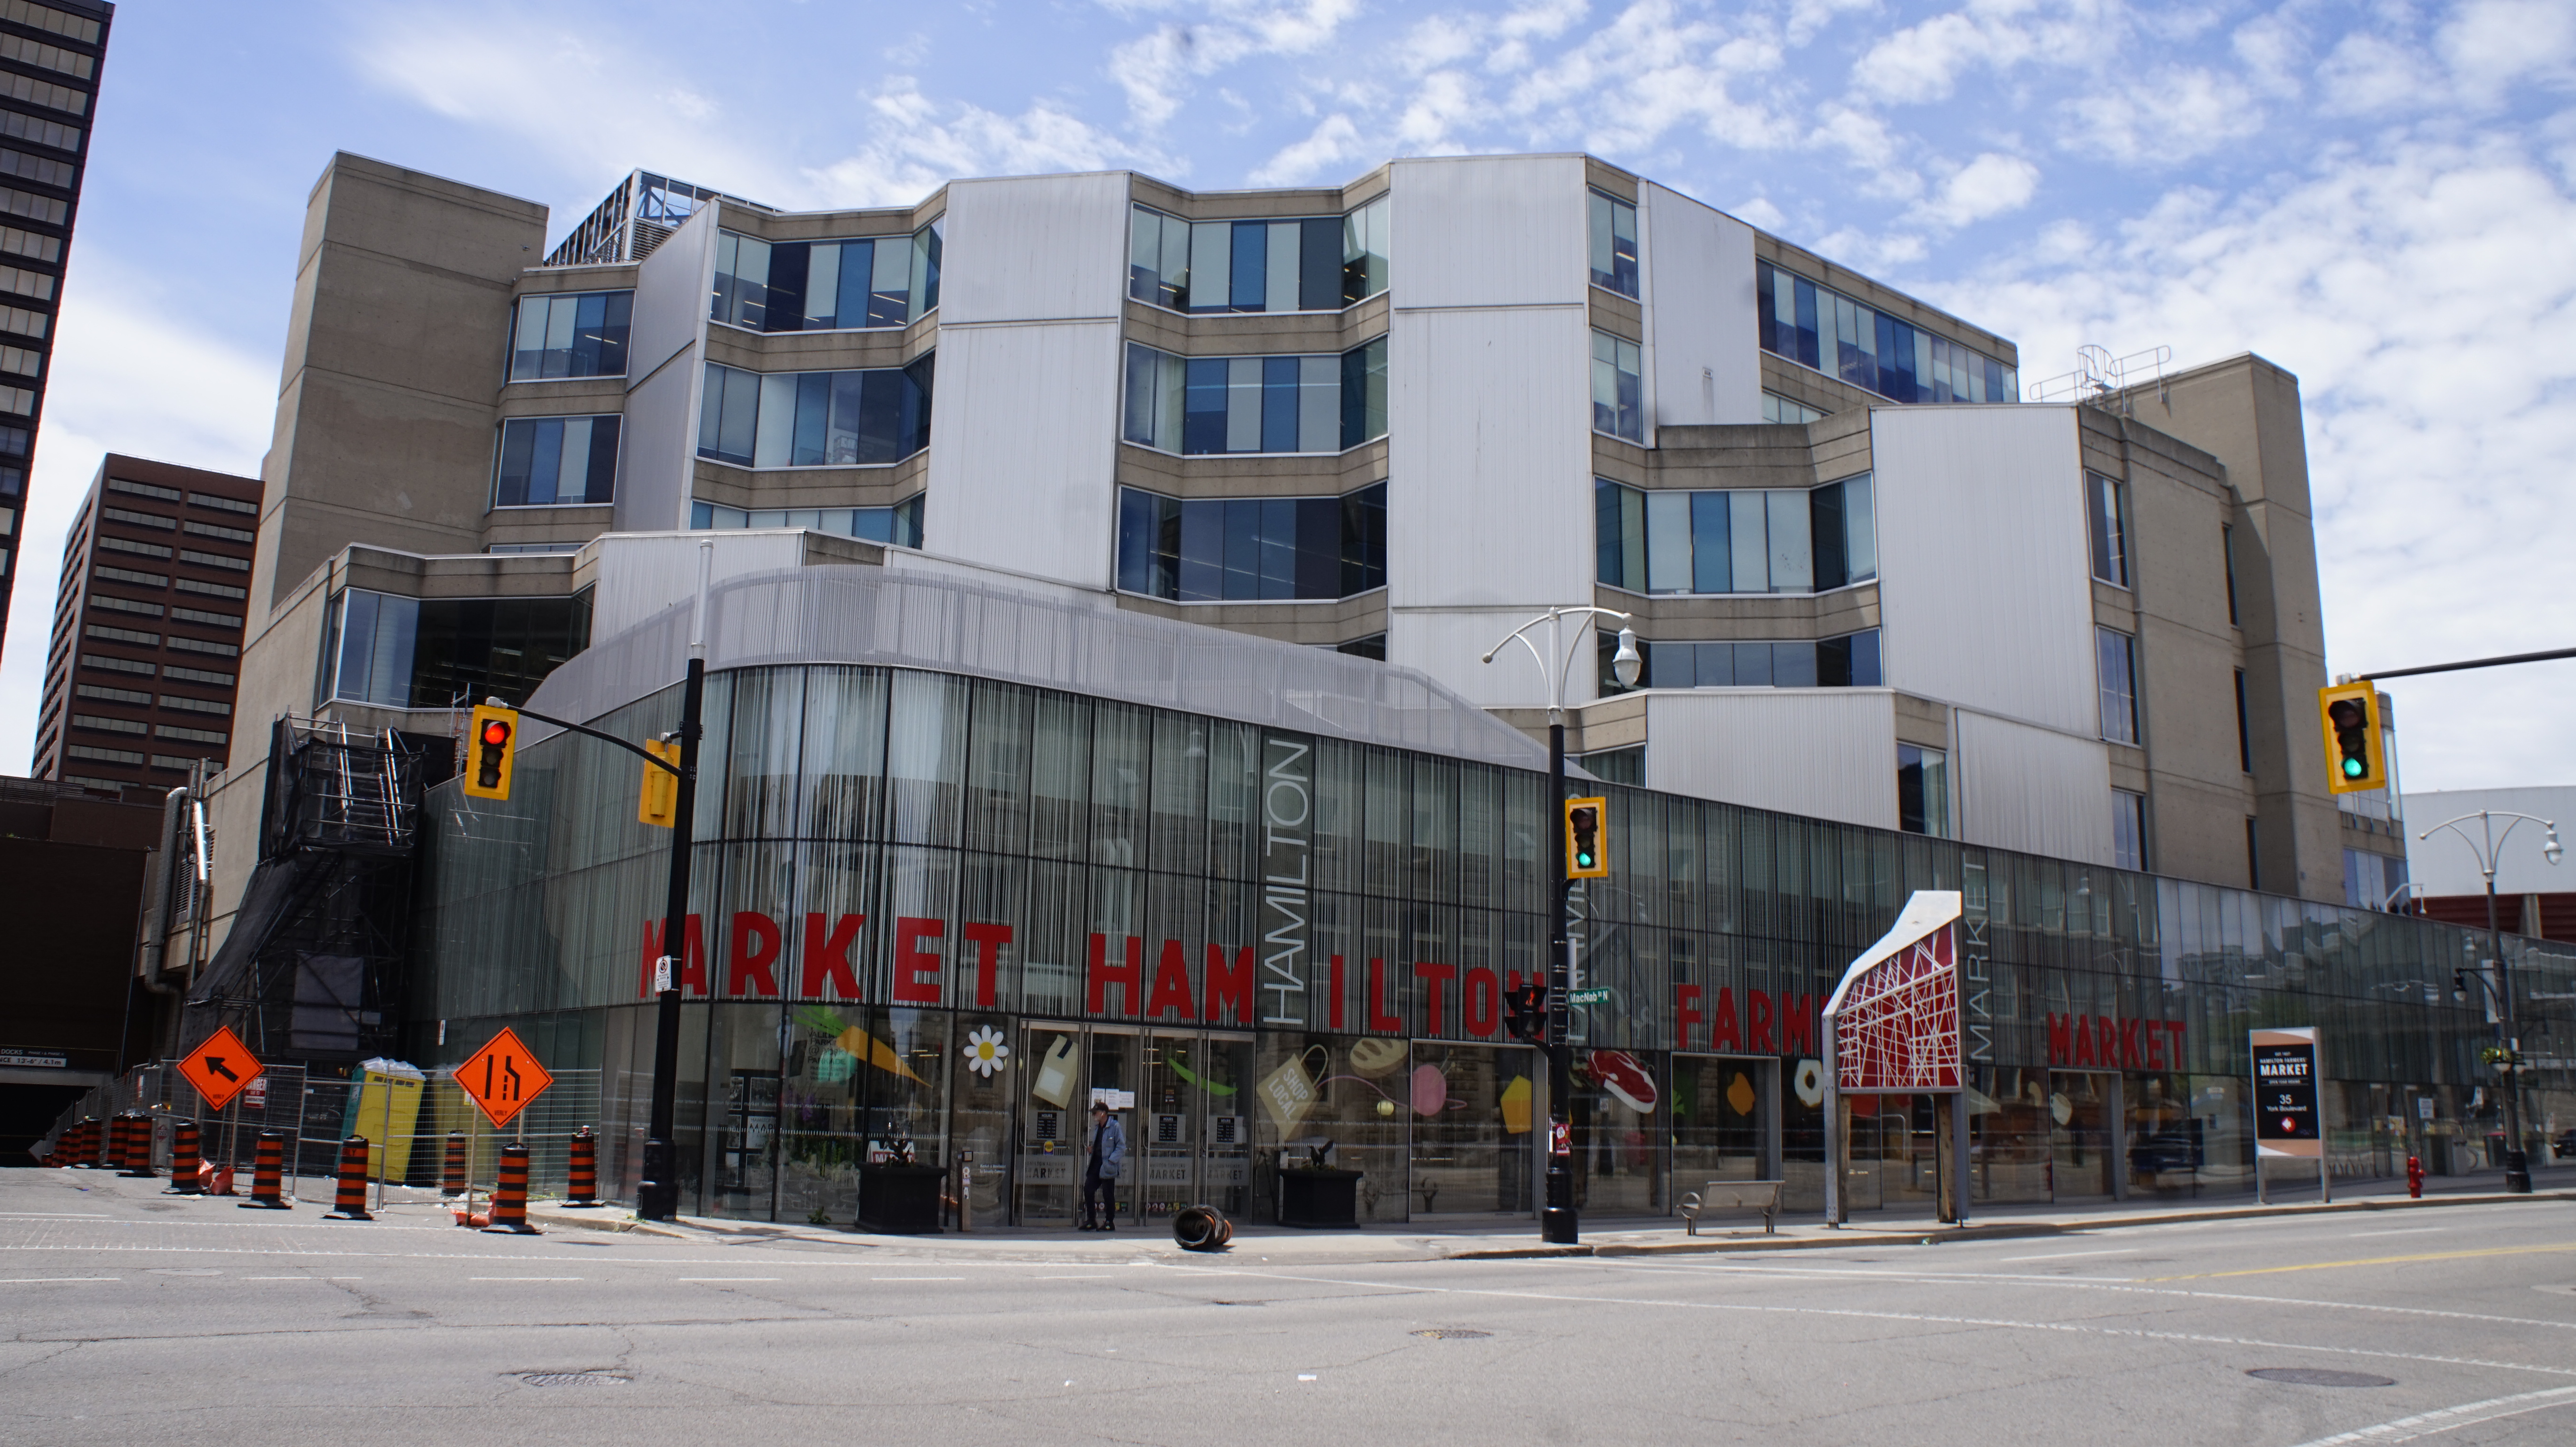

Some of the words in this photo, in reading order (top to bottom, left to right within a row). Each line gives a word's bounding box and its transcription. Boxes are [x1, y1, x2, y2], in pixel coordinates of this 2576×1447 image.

[1263, 739, 1308, 1025] HAMILTON
[1963, 852, 1992, 1062] MARKET
[1569, 991, 1597, 1003] MacNab
[1603, 990, 1608, 1001] N
[1678, 984, 1832, 1054] FARM
[2048, 1012, 2186, 1071] MARKET
[1283, 1068, 1308, 1100] SHOP
[2260, 1064, 2308, 1076] MARKET
[1268, 1077, 1296, 1120] LOCAL
[2279, 1094, 2292, 1105] 35
